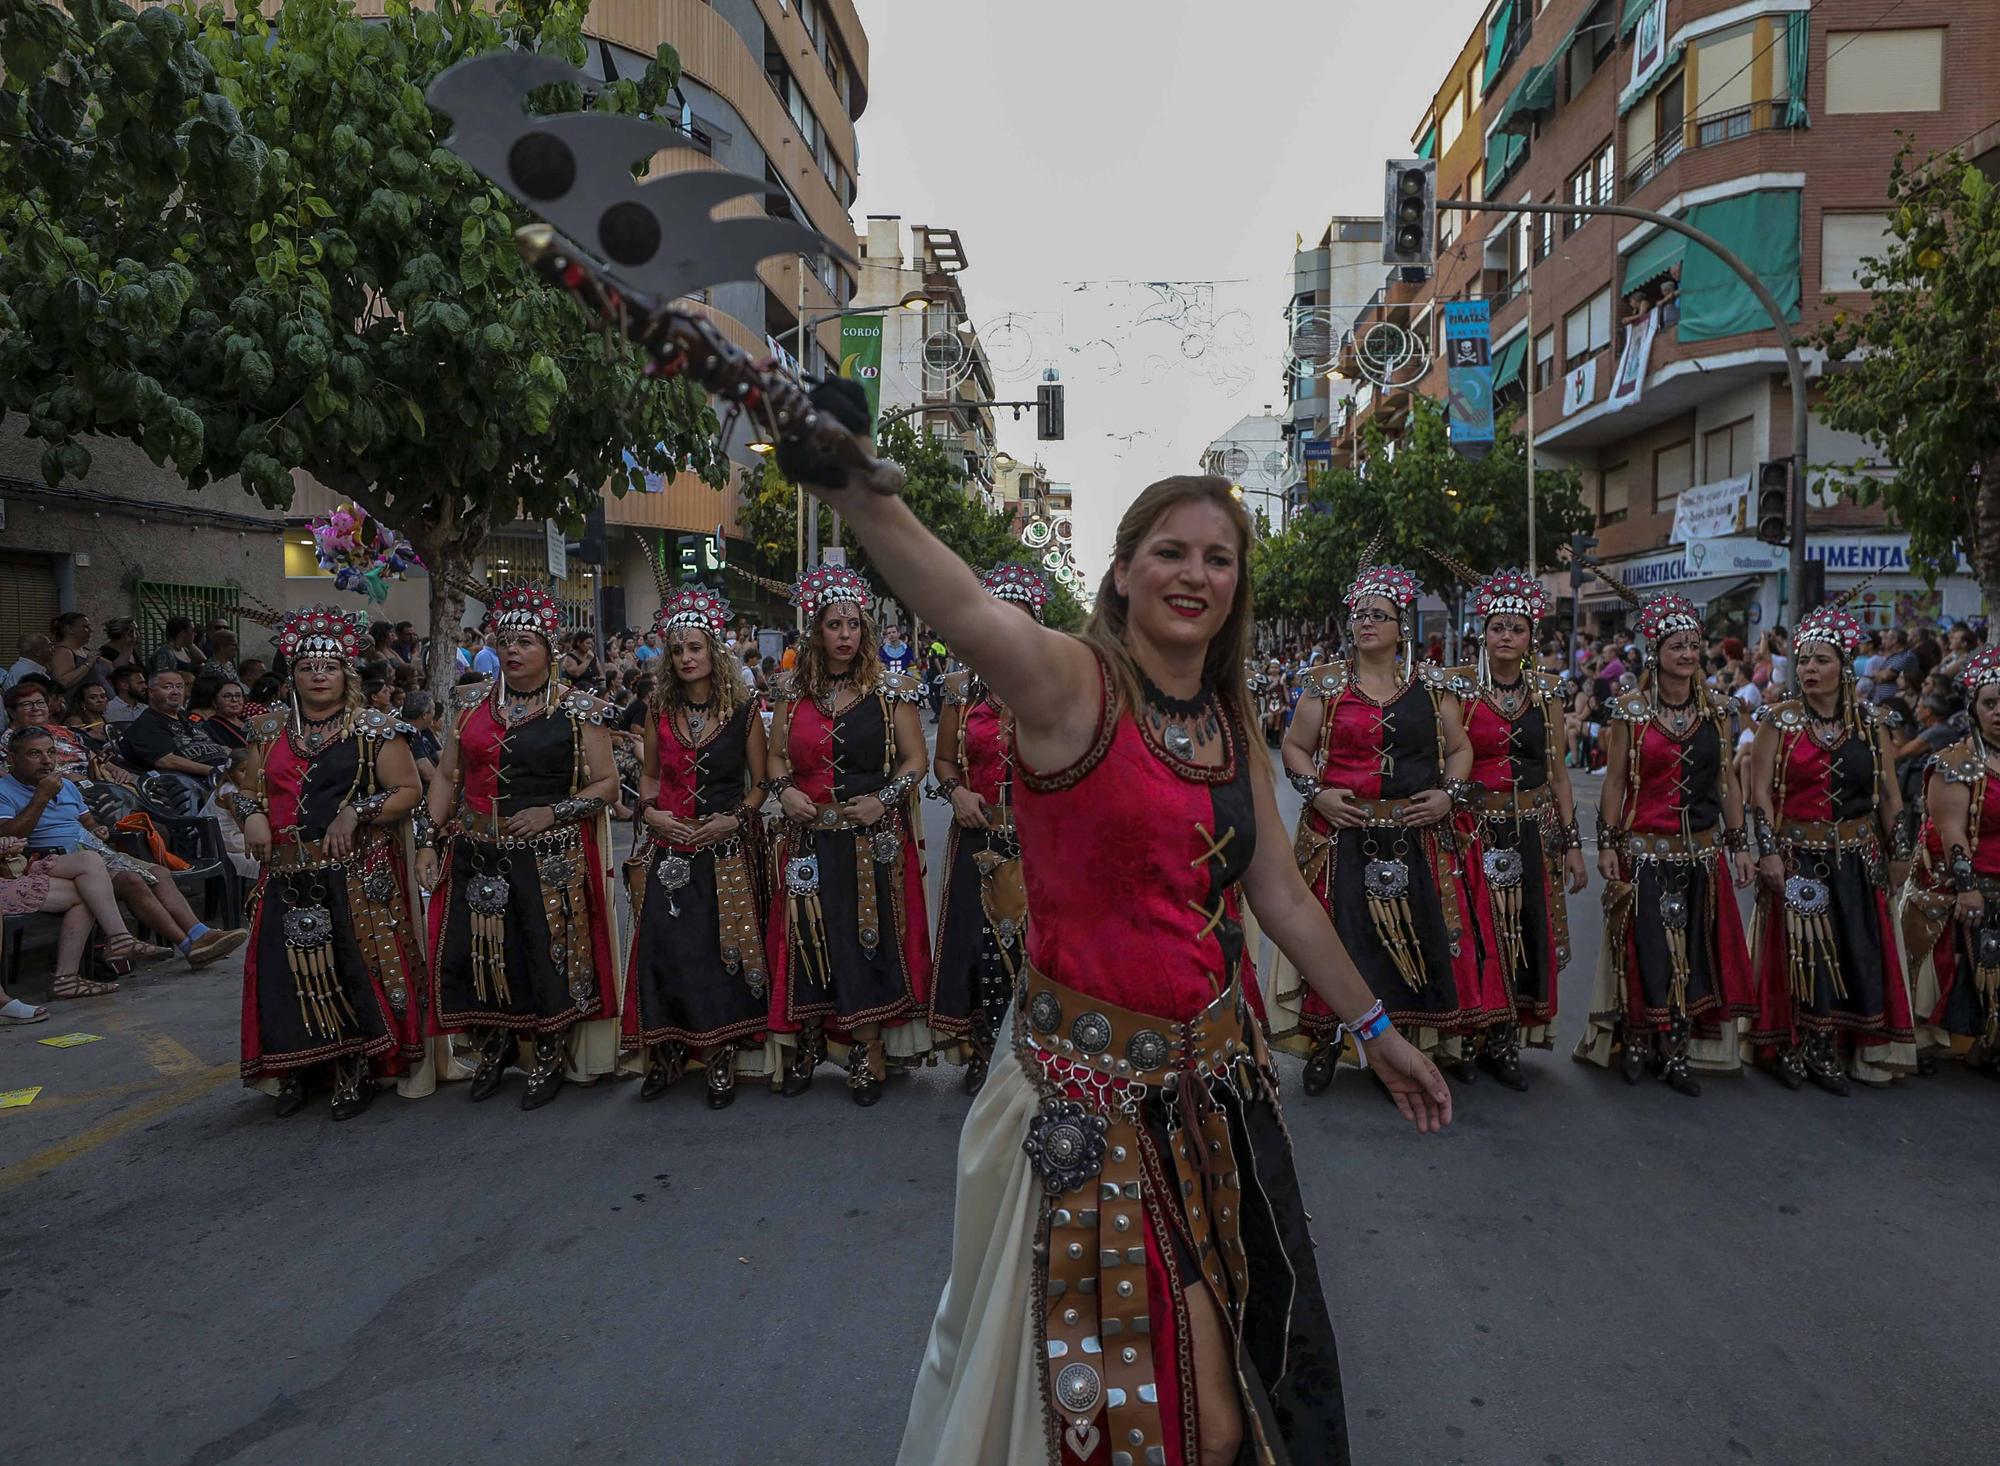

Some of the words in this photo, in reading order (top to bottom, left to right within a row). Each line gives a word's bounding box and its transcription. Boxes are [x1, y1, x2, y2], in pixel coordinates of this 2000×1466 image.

[1449, 313, 1488, 324] PIRATES
[843, 326, 880, 337] CORDÓ
[1622, 554, 1697, 586] ALIMENTACIÓ
